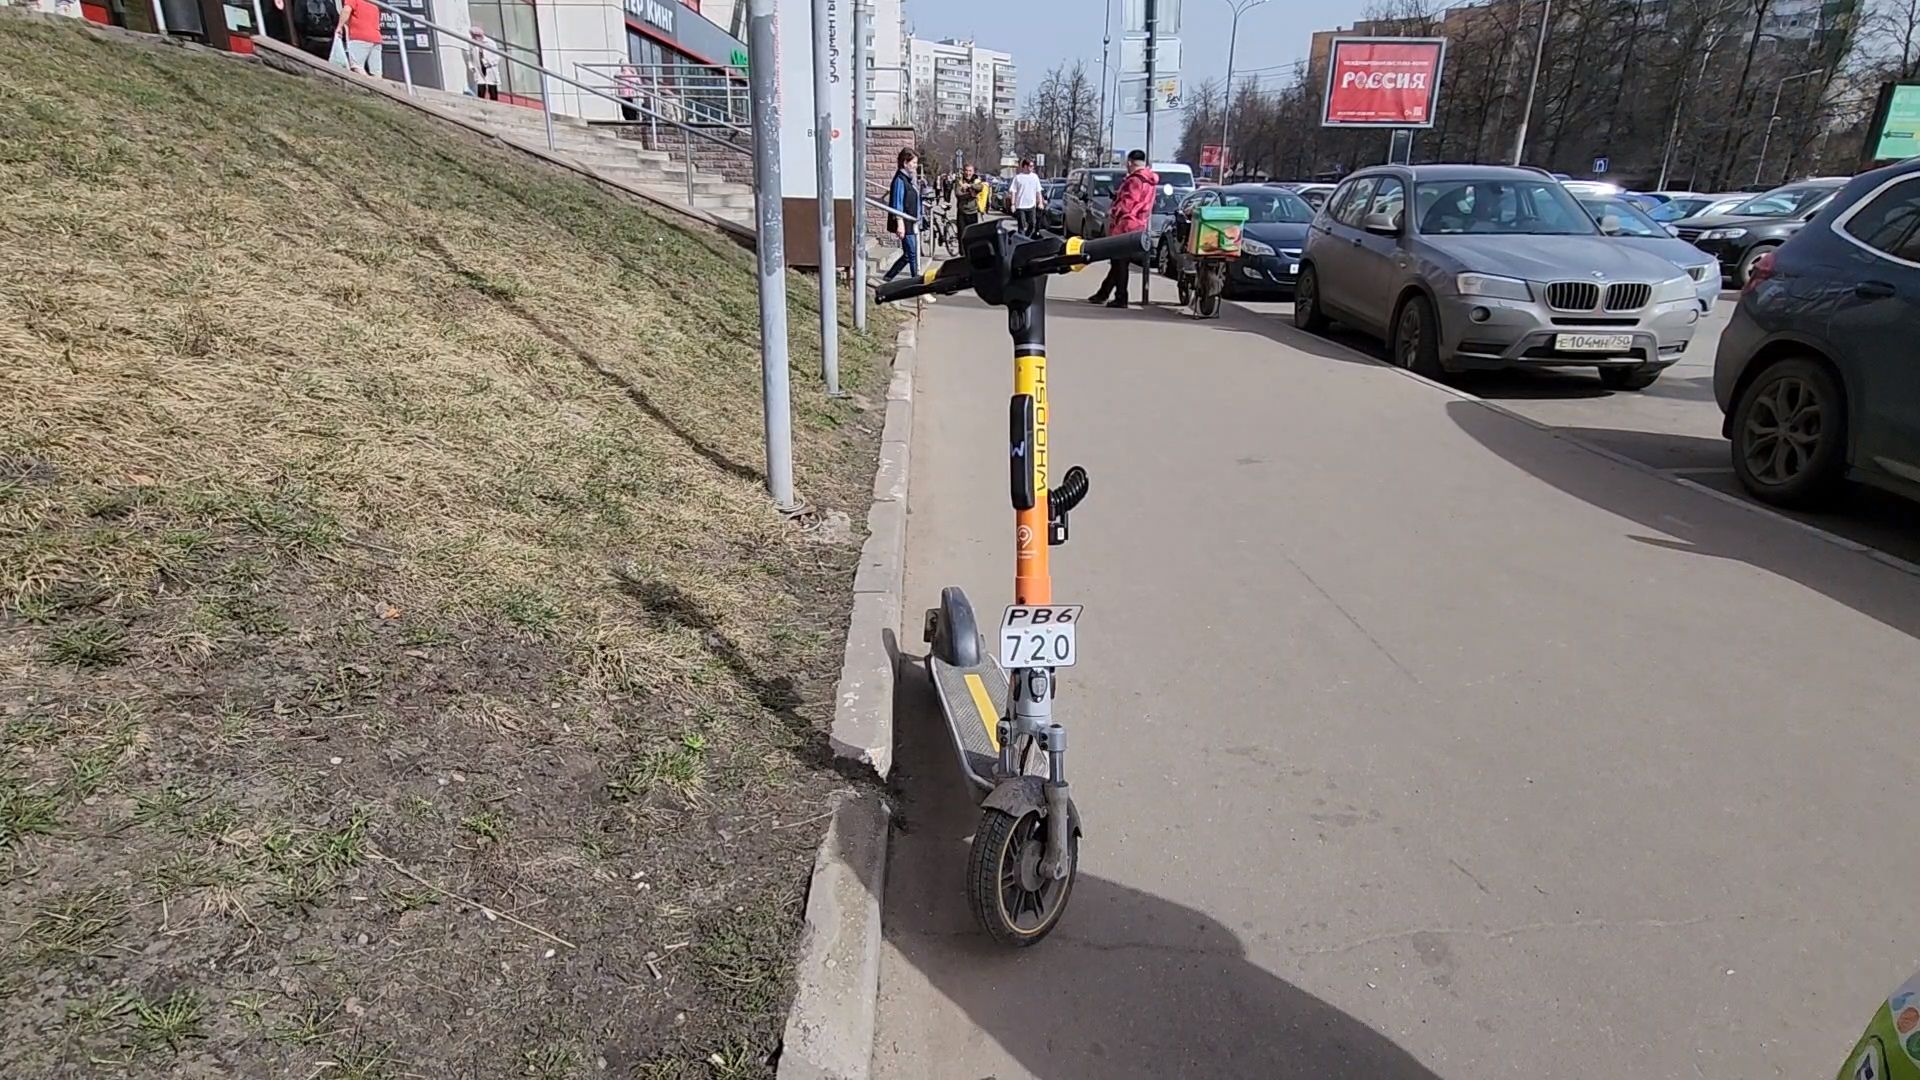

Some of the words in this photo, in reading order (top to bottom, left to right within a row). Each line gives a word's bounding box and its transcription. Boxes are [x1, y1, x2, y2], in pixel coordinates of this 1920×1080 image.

[646, 0, 674, 32] КИНГ
[1341, 71, 1427, 89] РОССИЯ
[1035, 365, 1047, 492] WHOOSH
[1006, 634, 1070, 662] 720
